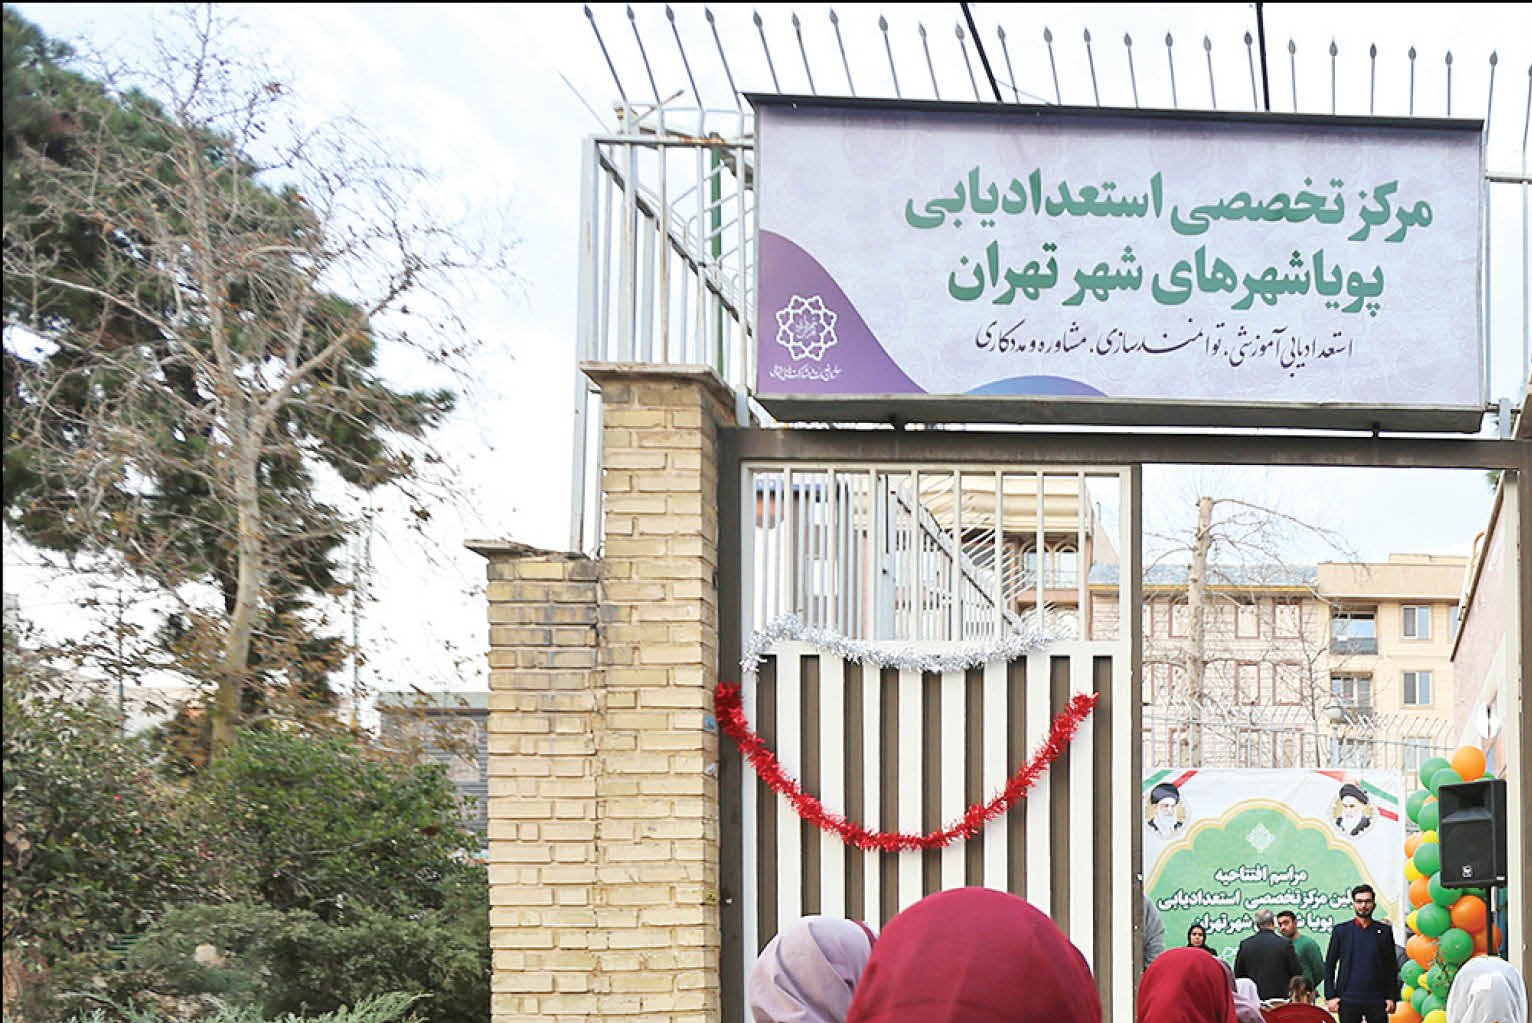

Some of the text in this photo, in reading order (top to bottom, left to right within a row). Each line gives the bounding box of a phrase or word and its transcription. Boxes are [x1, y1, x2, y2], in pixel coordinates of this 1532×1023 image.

[904, 164, 1433, 242] مرکز تخصصی استعدادیابی
[948, 240, 1059, 305] تهران
[1062, 245, 1143, 307] شهر
[1039, 321, 1087, 354] مشاوره
[1280, 331, 1354, 378] استعدادیابی
[1214, 864, 1308, 886] مراسم افتتاحیه
[1158, 888, 1241, 911] استعدادیابی
[1244, 887, 1301, 910] تخصصی
[1300, 888, 1328, 910] مرکز
[1228, 912, 1254, 935] شهر
[1304, 912, 1334, 933] پویا
